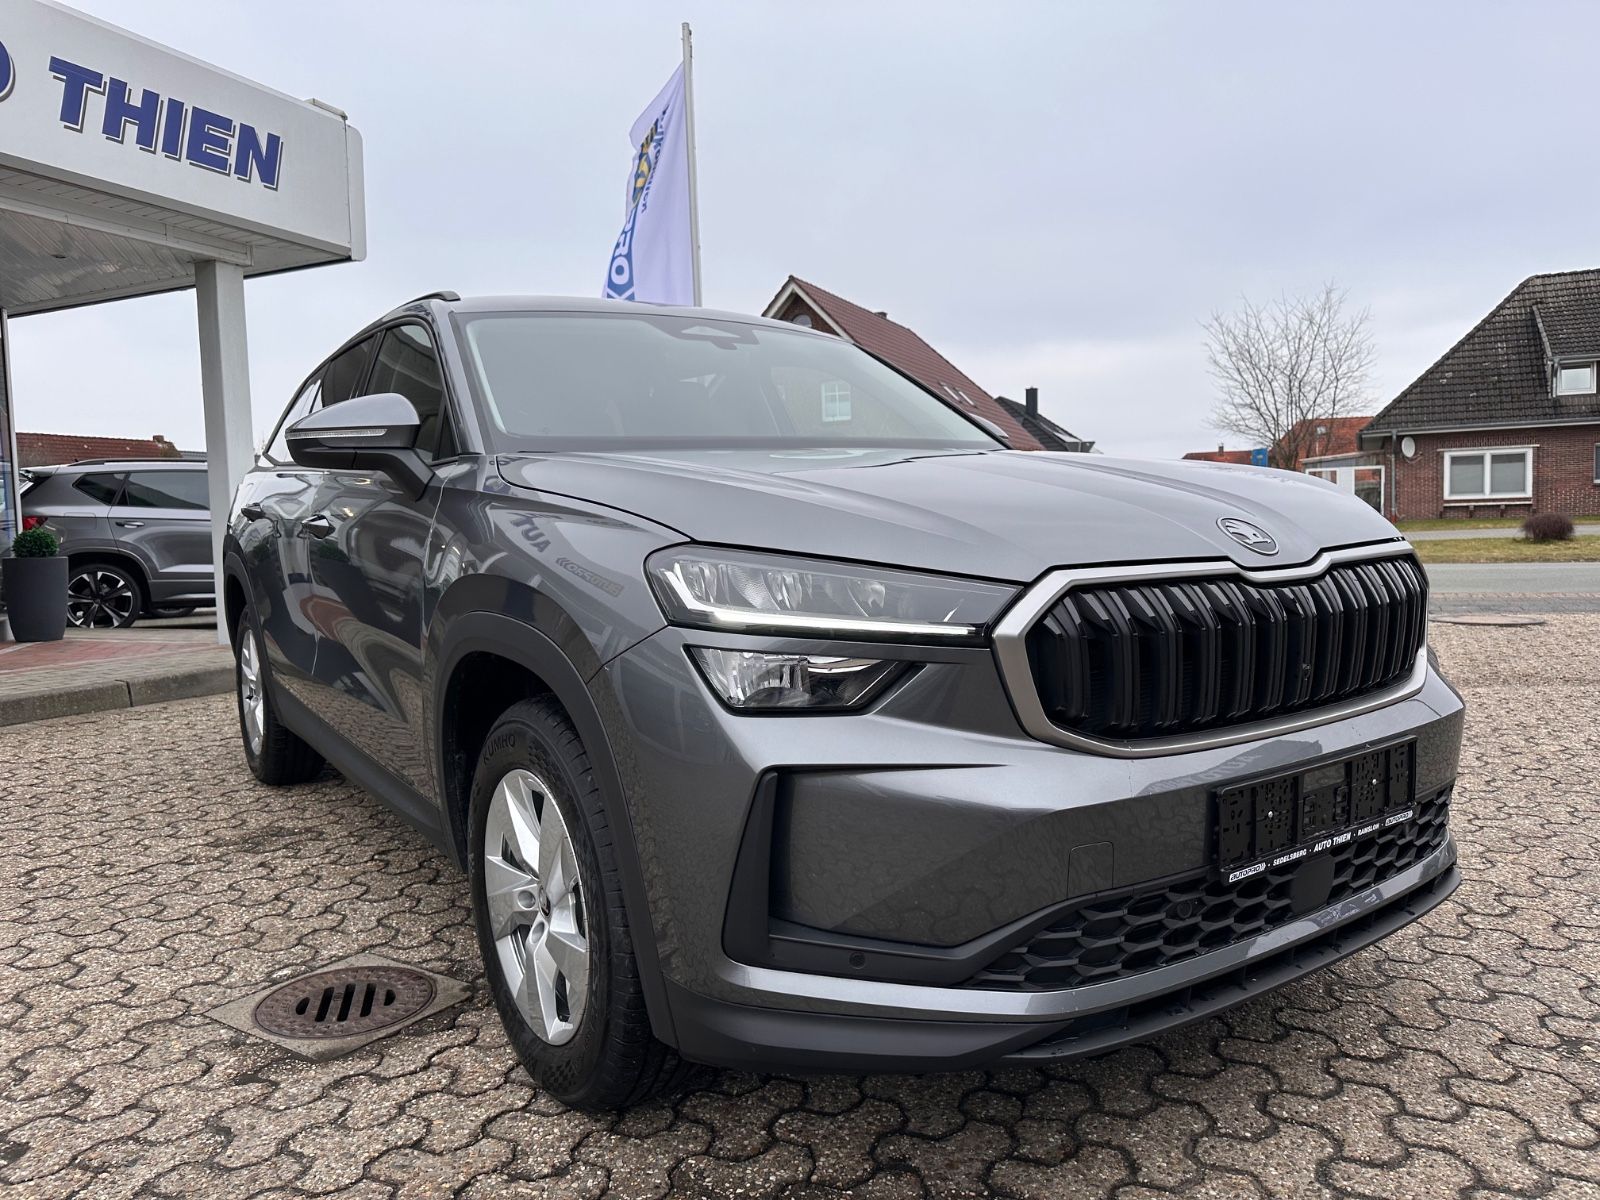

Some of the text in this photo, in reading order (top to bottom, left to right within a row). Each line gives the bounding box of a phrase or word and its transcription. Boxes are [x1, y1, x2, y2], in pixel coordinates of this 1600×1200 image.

[49, 56, 282, 189] THIEN
[482, 734, 516, 765] KUMHO
[1273, 849, 1307, 866] SEDELSBERG
[1313, 838, 1332, 852] AUTO
[1333, 831, 1351, 846] THIEN
